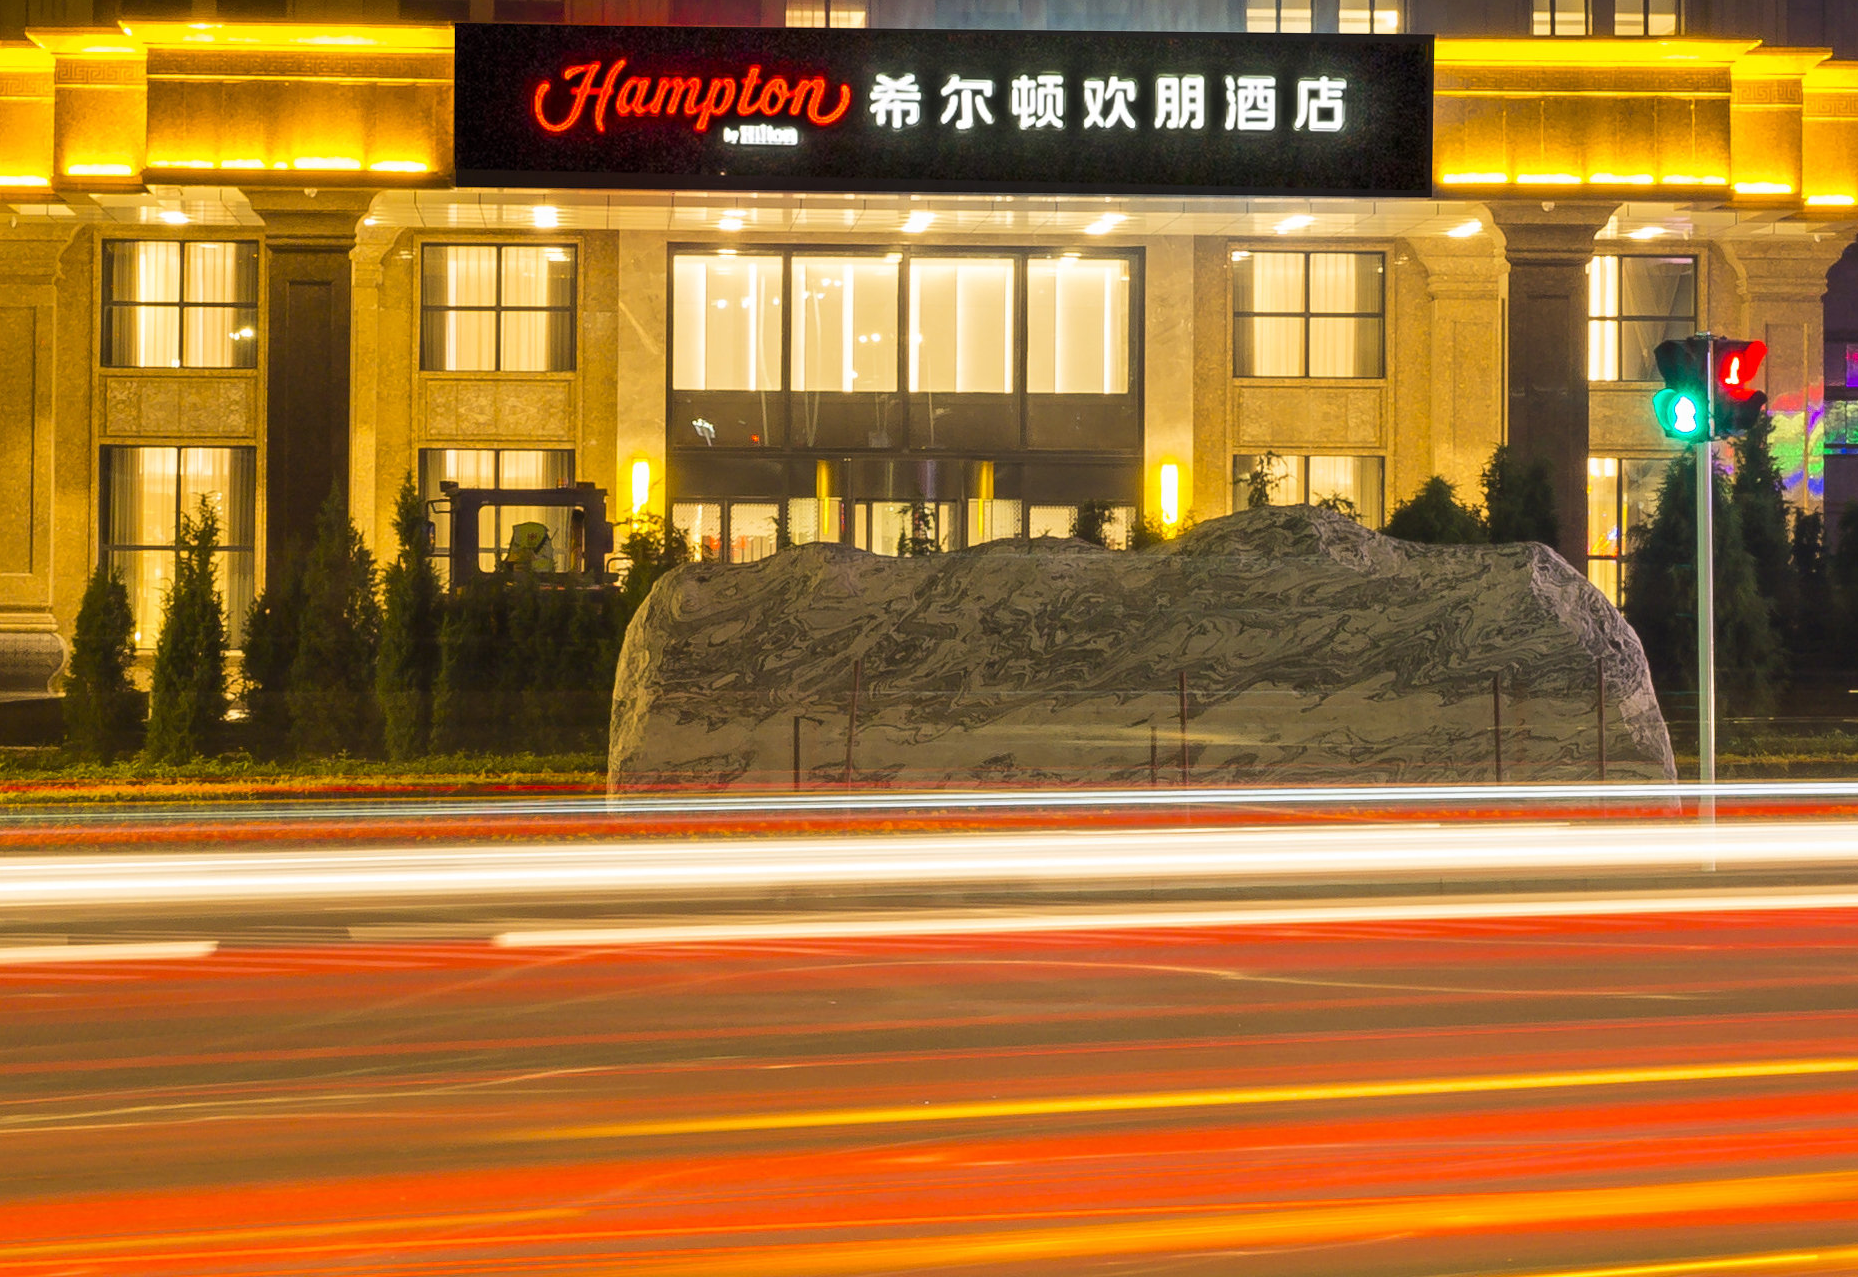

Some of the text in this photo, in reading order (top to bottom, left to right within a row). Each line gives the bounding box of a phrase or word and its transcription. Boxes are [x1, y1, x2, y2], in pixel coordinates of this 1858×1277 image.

[534, 58, 851, 133] Hampton
[869, 72, 1348, 133] 希尔顿欢朋酒店
